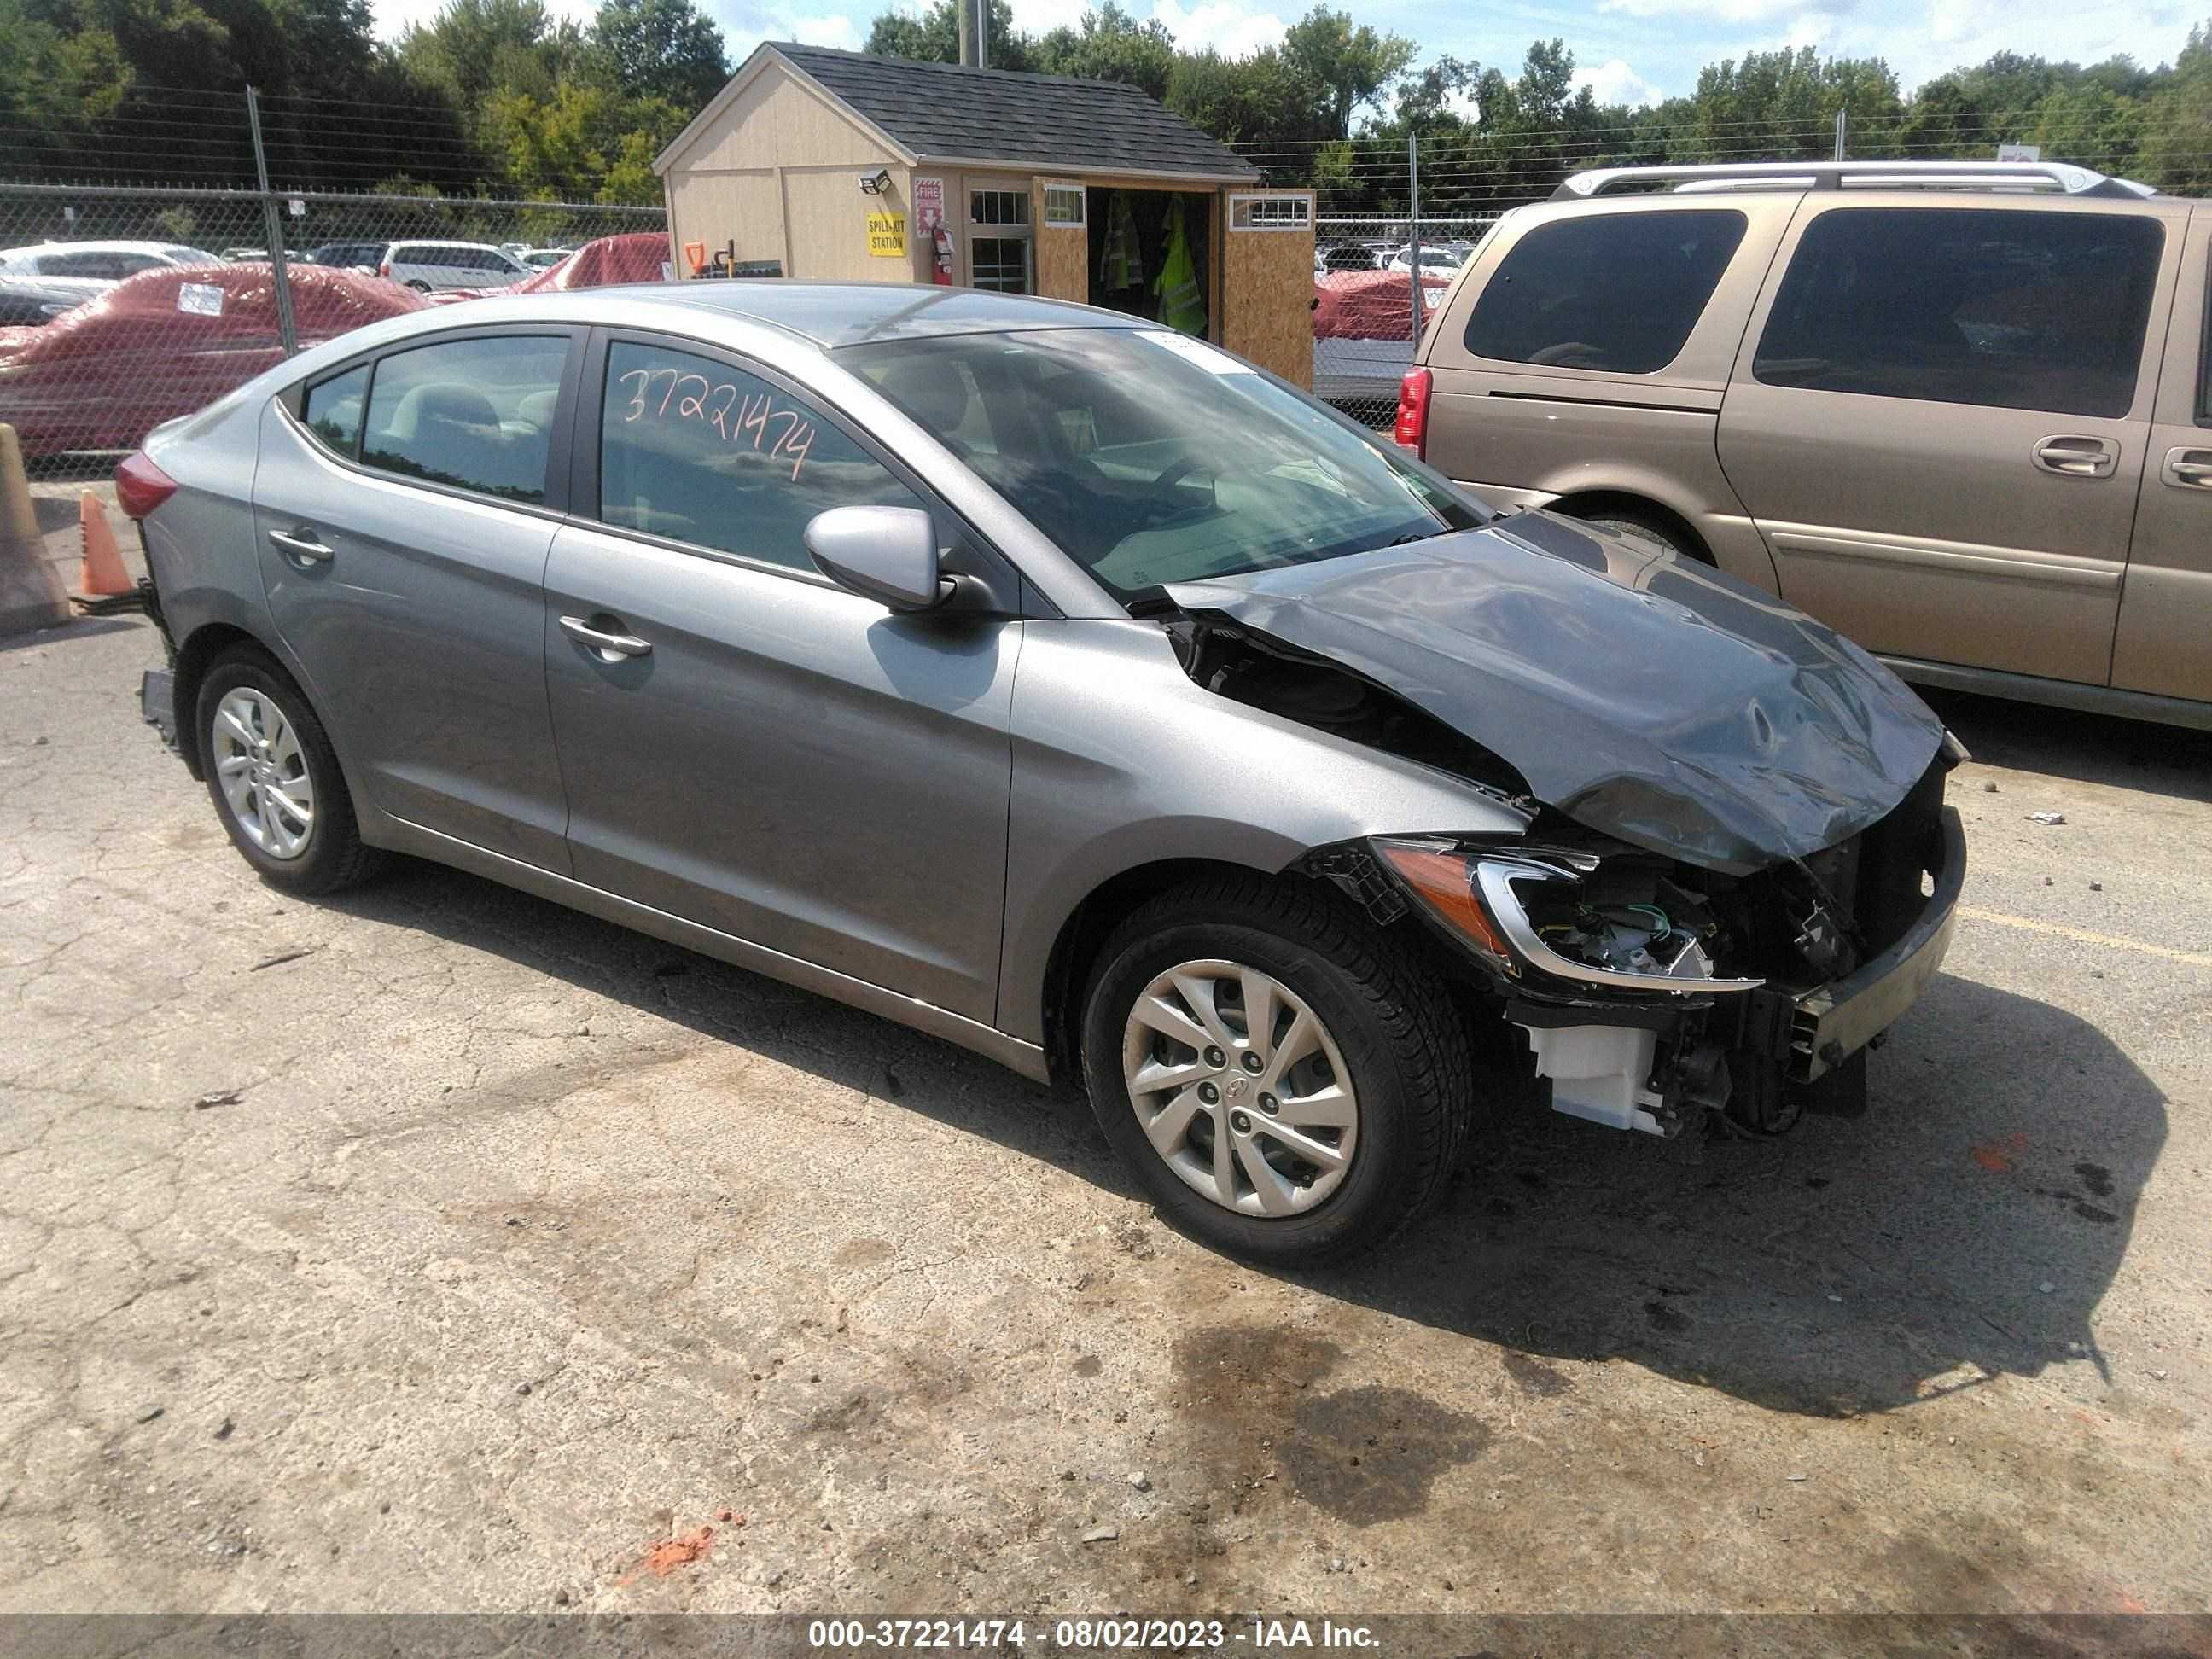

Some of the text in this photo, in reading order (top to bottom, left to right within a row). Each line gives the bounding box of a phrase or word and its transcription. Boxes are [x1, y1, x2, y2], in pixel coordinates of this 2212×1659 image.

[919, 187, 940, 198] FIRE
[869, 220, 905, 233] SPILL-KIT
[872, 236, 903, 249] STATION
[619, 368, 815, 481] 37221474
